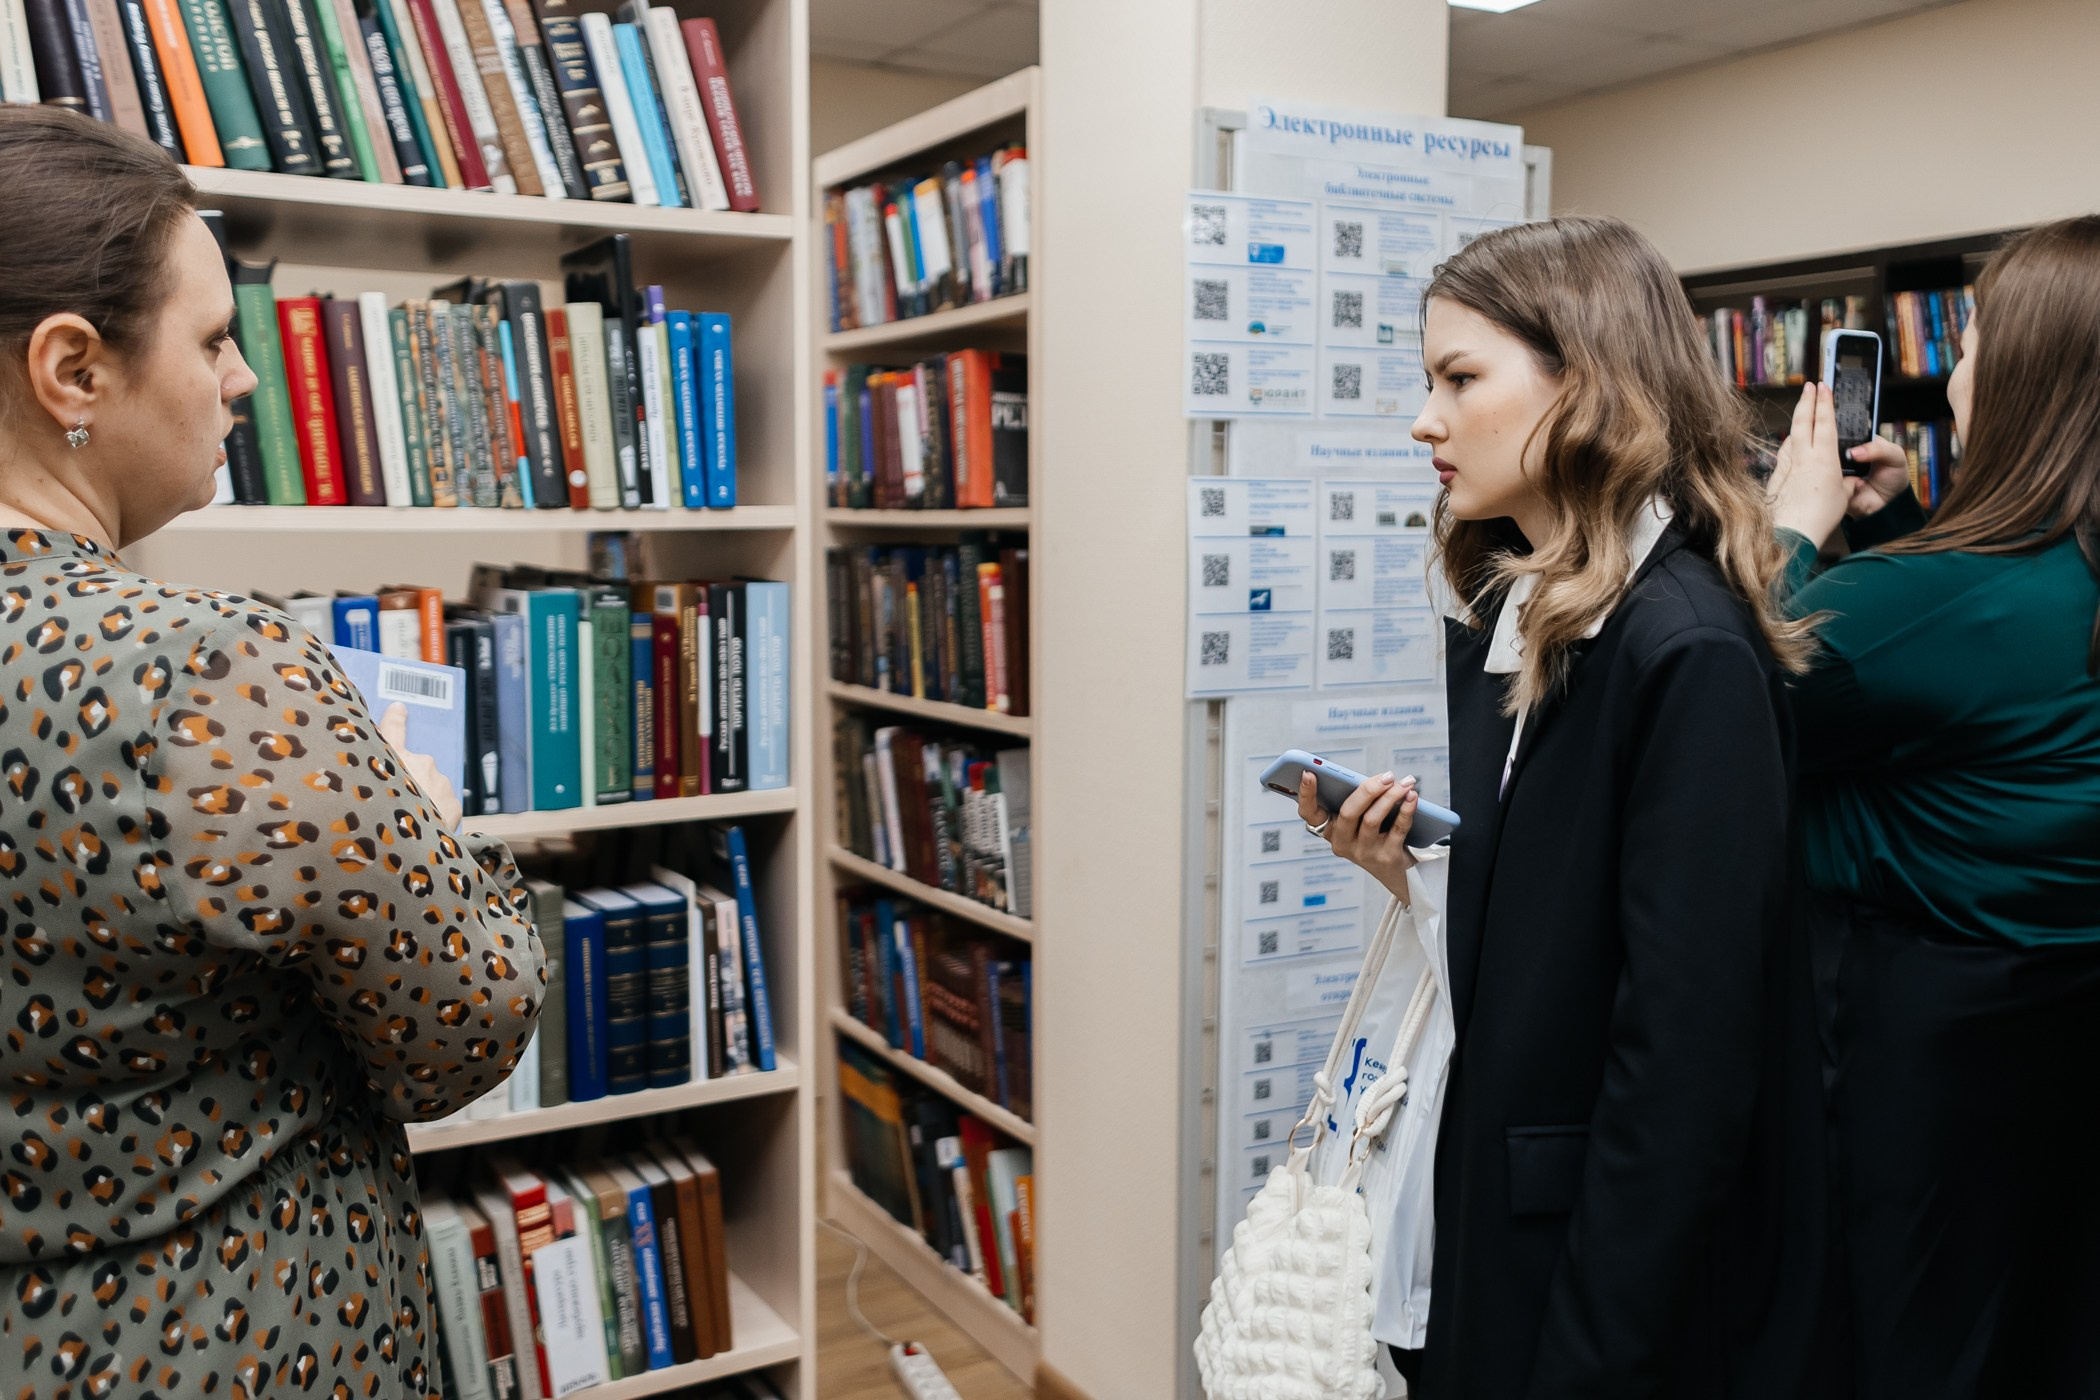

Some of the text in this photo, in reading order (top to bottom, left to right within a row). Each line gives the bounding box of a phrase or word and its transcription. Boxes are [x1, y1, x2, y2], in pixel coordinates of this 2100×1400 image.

[1258, 104, 1511, 160] Электронные ресурсы
[1356, 166, 1430, 186] Электронные
[1407, 192, 1455, 207] системы
[1310, 444, 1362, 460] Научные
[1364, 446, 1410, 458] издания
[1328, 704, 1426, 721] Научные издания
